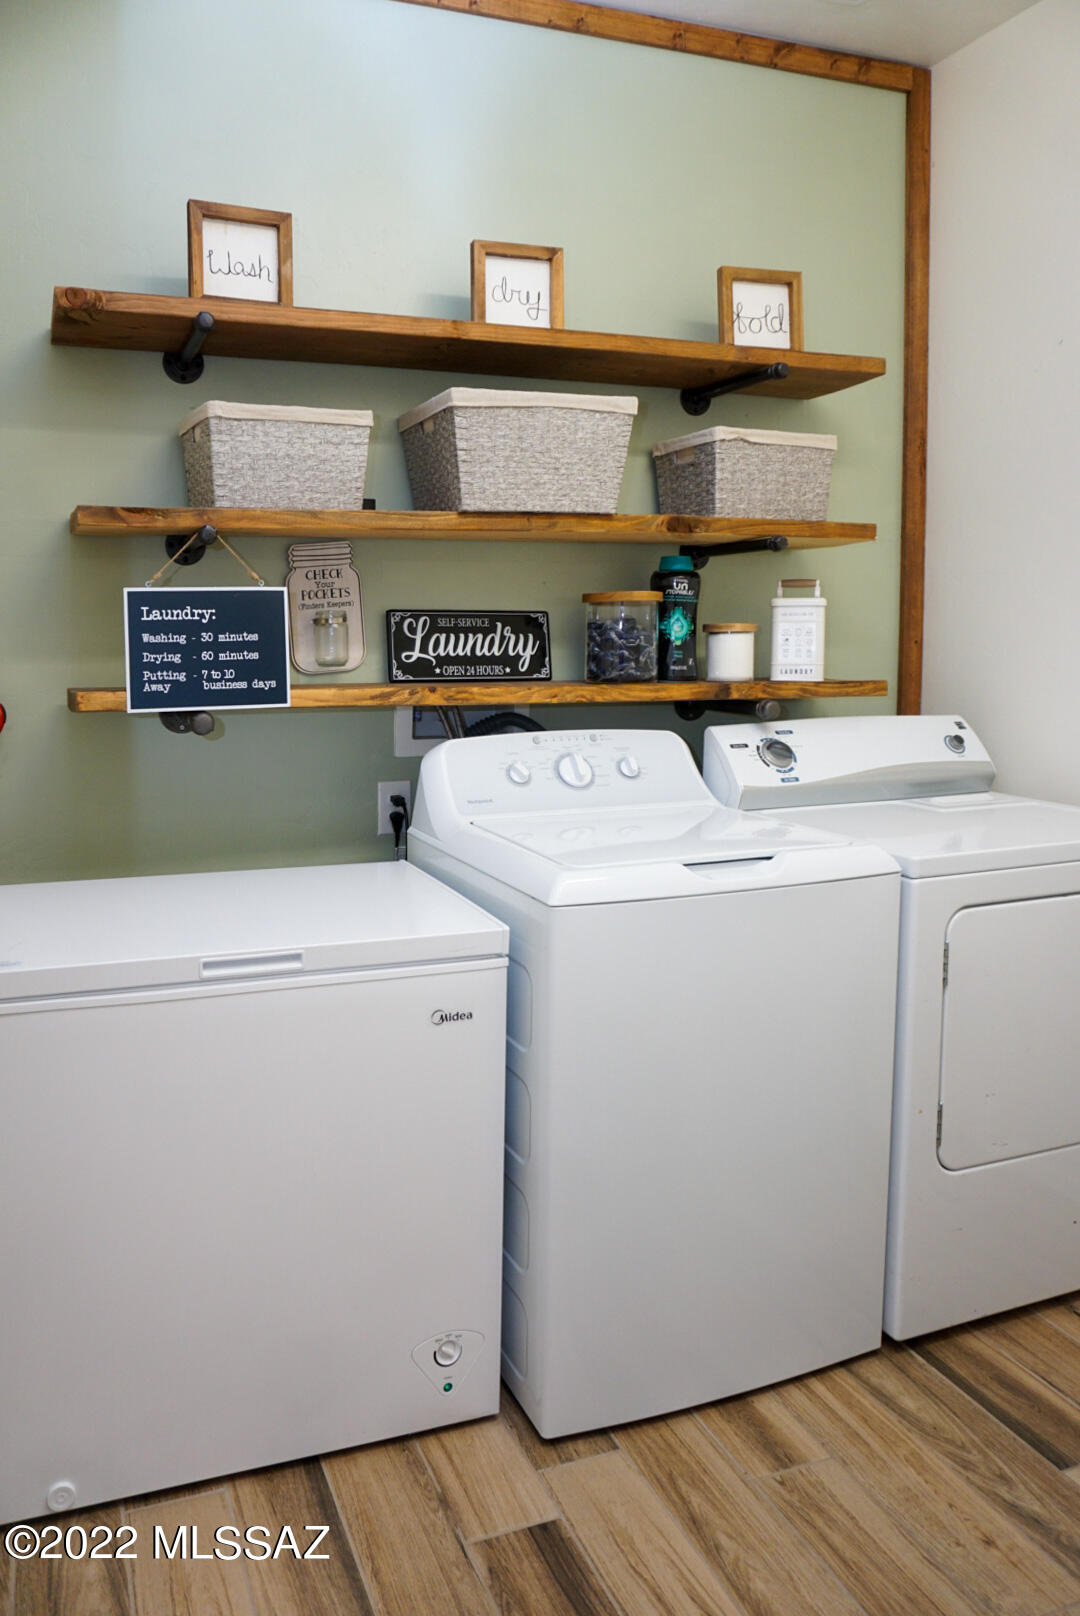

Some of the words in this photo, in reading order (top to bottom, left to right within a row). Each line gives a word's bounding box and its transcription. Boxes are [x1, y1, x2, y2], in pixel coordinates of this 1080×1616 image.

[492, 275, 548, 321] dry
[733, 302, 788, 334] fold
[305, 568, 343, 580] CHECK
[314, 581, 335, 589] Your
[301, 587, 351, 601] POCKETS
[140, 606, 216, 623] Laundry:
[437, 617, 490, 627] SELF-SERVICE
[142, 633, 186, 644] Washing
[200, 632, 214, 642] 30
[218, 632, 259, 642] minutes
[401, 616, 540, 672] Laundry
[142, 652, 181, 663] Drying
[201, 651, 214, 661] 60
[219, 650, 259, 660] minutes
[143, 671, 186, 682] Putting
[201, 670, 208, 679] 7
[211, 670, 221, 679] to
[224, 669, 235, 679] 10
[442, 665, 466, 676] OPEN
[466, 665, 475, 676] 24
[476, 665, 504, 675] HOURS
[143, 682, 171, 693] Away
[203, 680, 248, 690] business
[252, 679, 277, 690] days
[431, 1009, 473, 1025] Midea
